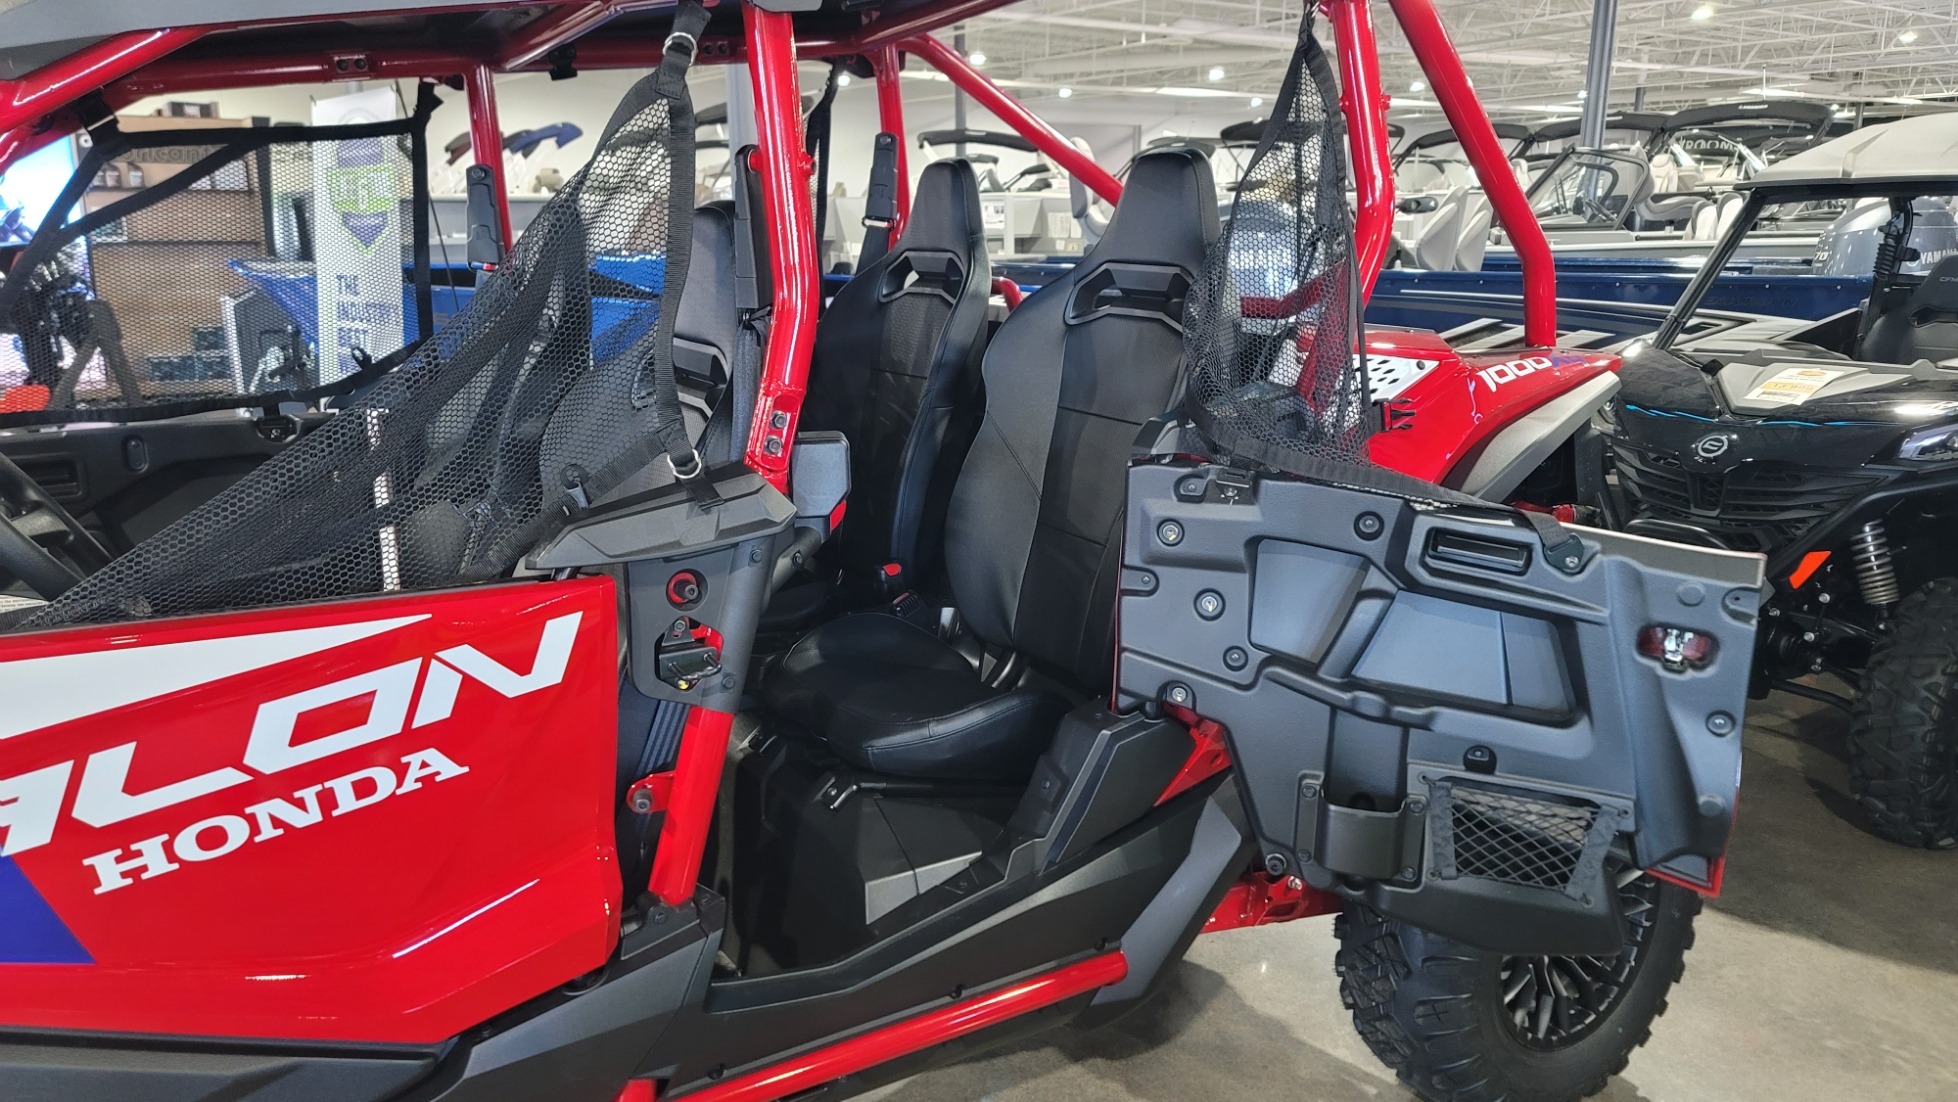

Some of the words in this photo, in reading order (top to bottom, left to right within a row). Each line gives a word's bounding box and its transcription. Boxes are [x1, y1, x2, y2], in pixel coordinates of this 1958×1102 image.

[336, 274, 360, 296] THE
[1475, 356, 1553, 393] 1000
[82, 747, 470, 895] HONDA
